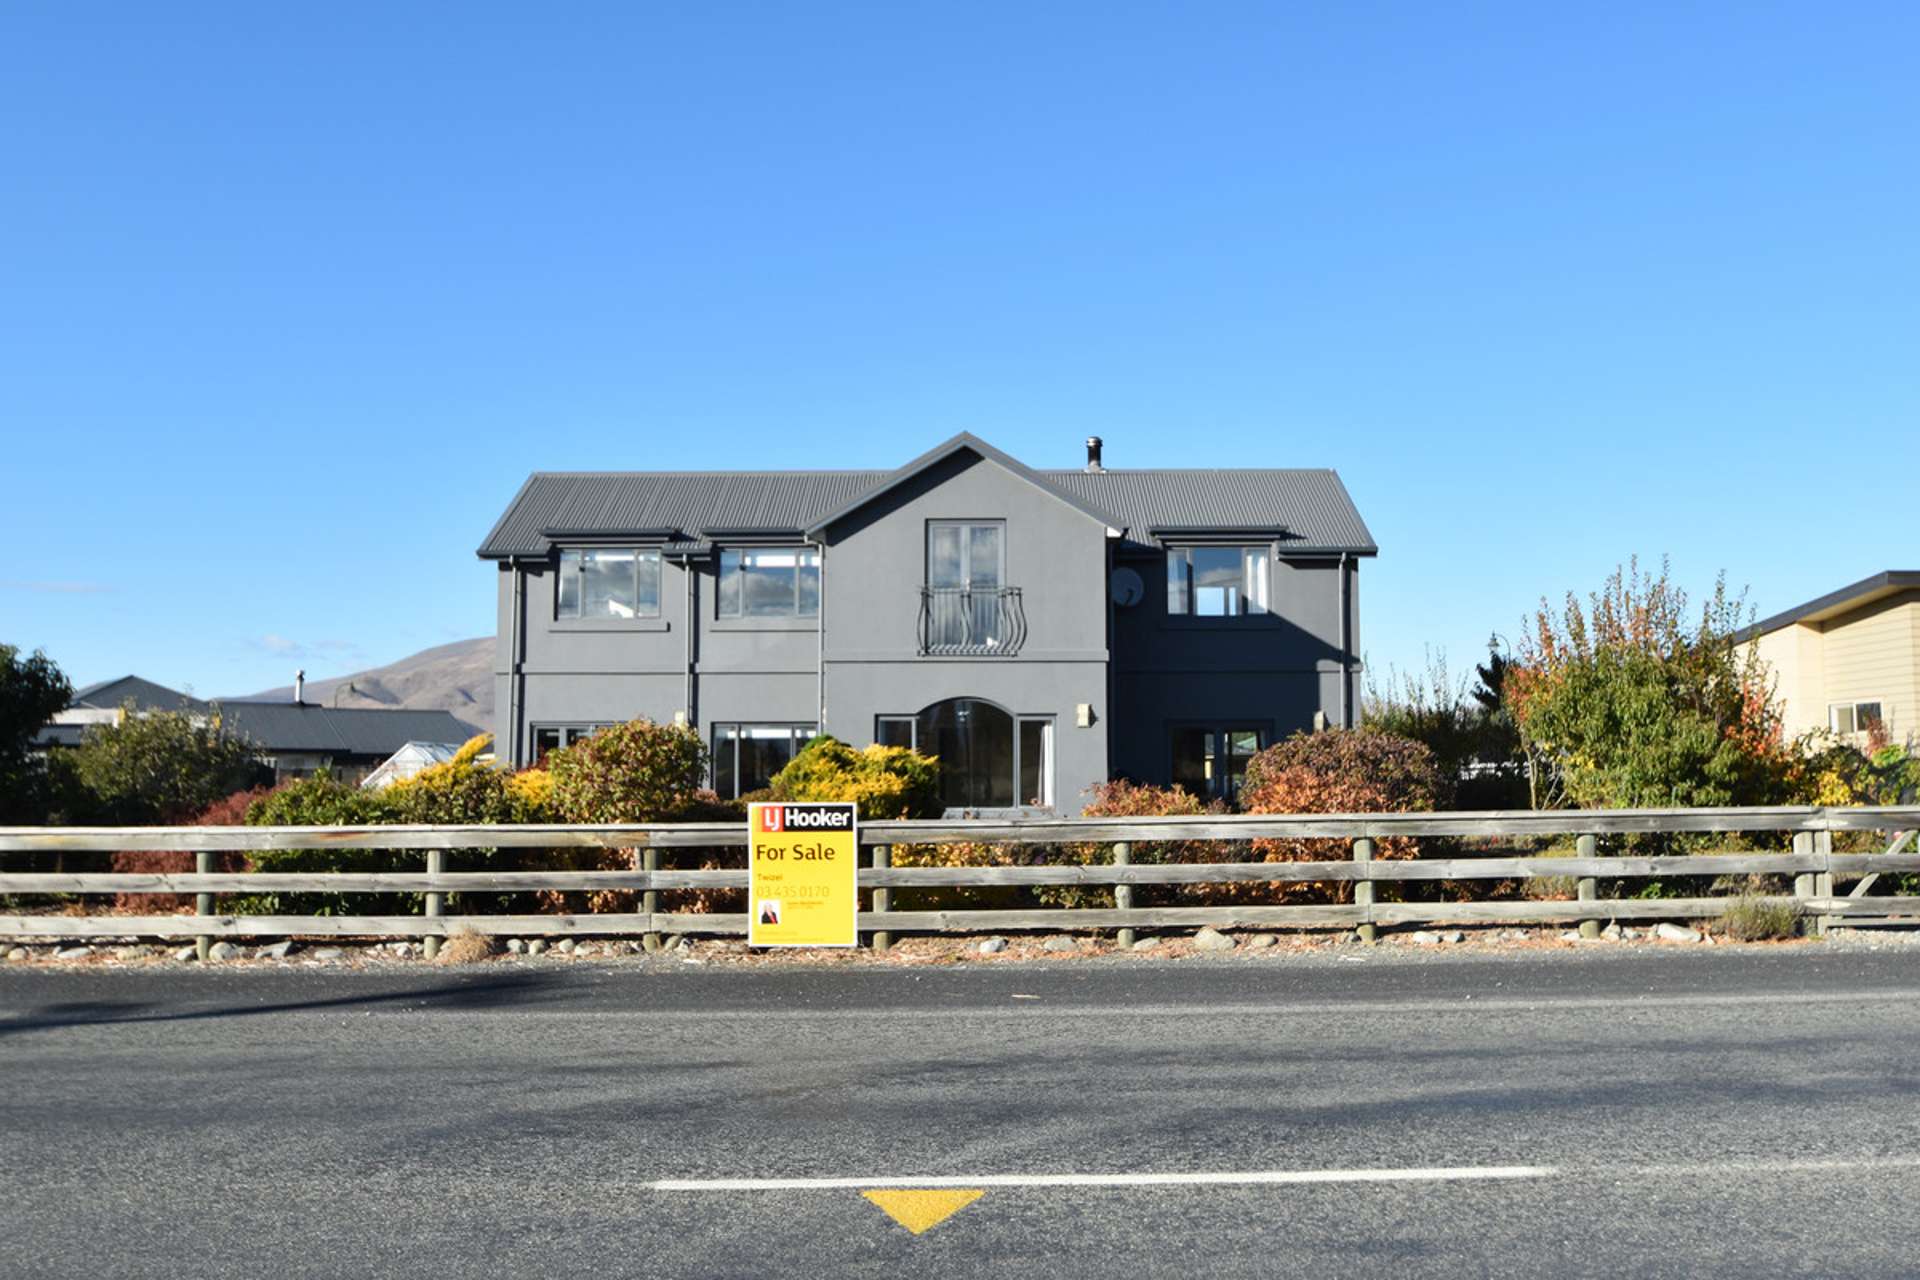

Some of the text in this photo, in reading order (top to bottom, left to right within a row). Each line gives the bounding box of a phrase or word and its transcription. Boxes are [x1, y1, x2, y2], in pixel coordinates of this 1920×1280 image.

[764, 808, 850, 831] LJ Hooker
[756, 843, 835, 861] For Sale
